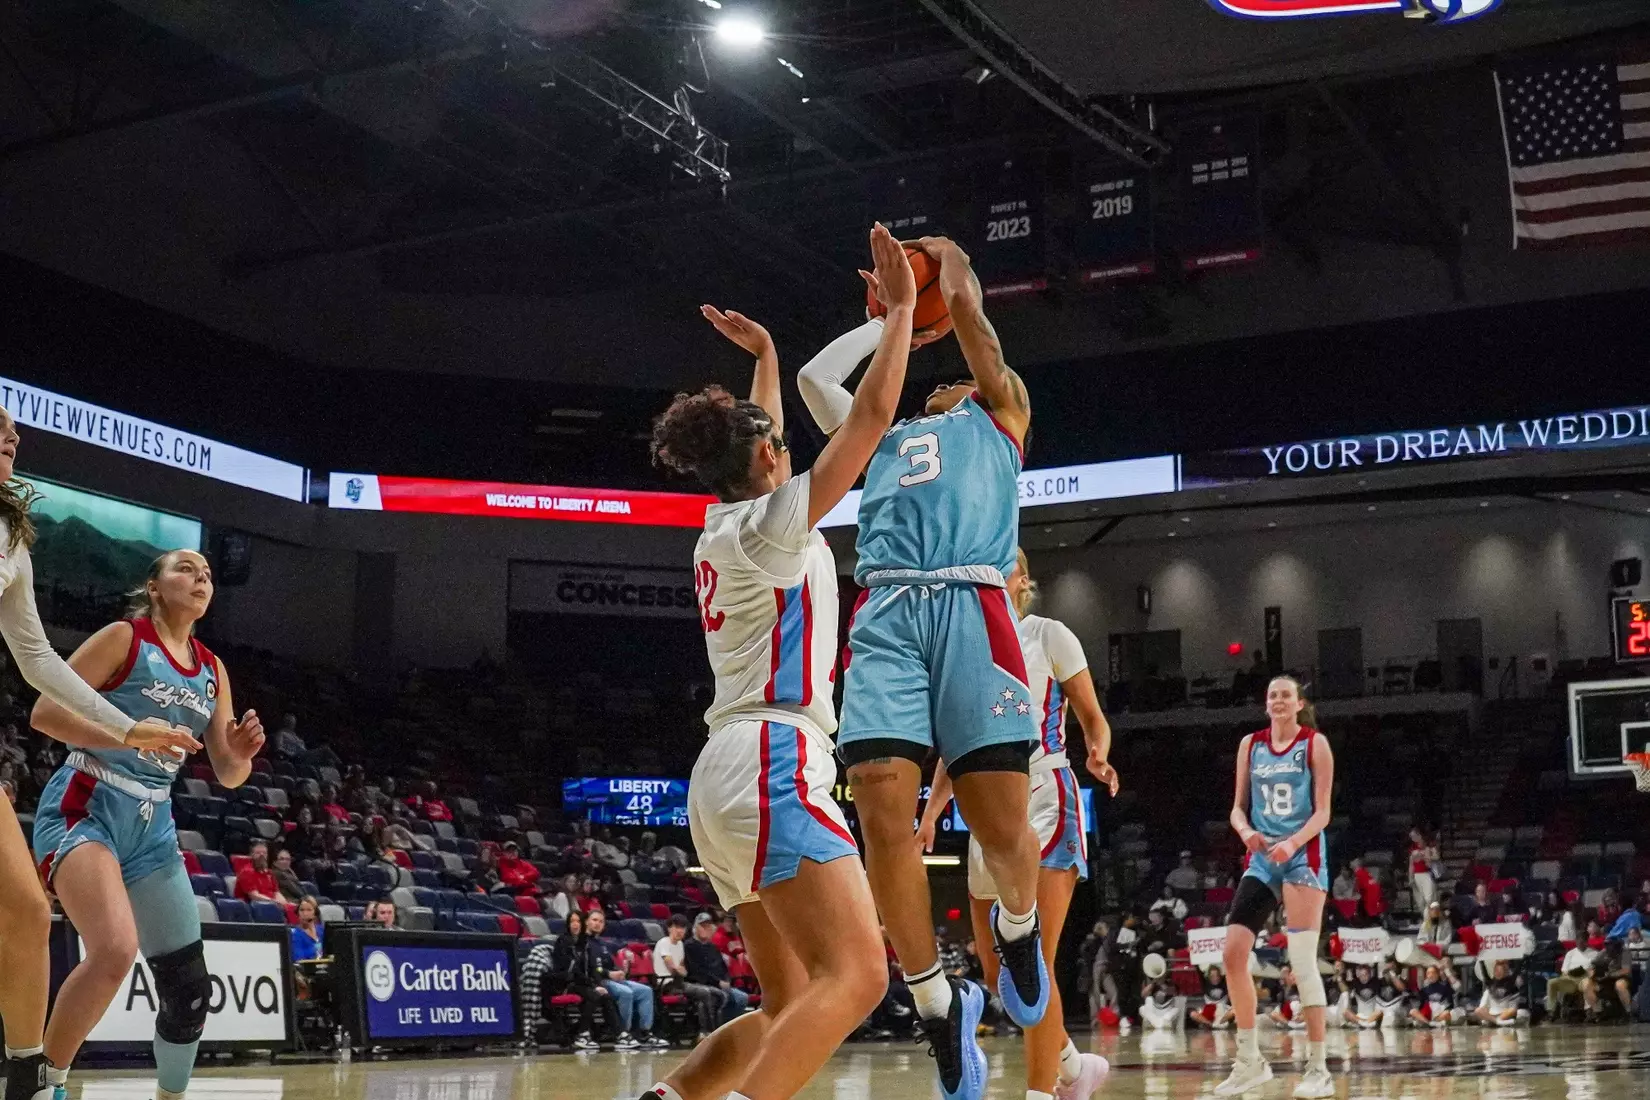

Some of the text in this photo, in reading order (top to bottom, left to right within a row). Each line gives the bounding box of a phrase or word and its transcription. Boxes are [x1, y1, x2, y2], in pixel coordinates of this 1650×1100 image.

[1092, 195, 1133, 219] 2019
[986, 216, 1031, 242] 2023
[2, 386, 211, 471] TYVIEWVENUES.COM
[1263, 409, 1649, 475] YOUR DREAM WEDDI
[899, 432, 942, 487] 3
[486, 493, 632, 514] WELCOME TO LIBERTY ARENA
[556, 580, 695, 609] CONCESS
[1628, 620, 1650, 655] 2
[610, 780, 671, 793] LIBERTY
[1261, 783, 1293, 816] 18
[626, 795, 653, 815] 48
[1343, 938, 1382, 953] DEFENSE
[1479, 933, 1521, 949] DEFENSE
[400, 962, 511, 991] Carter Bank
[398, 1007, 499, 1024] LIFE LIVED FULL
